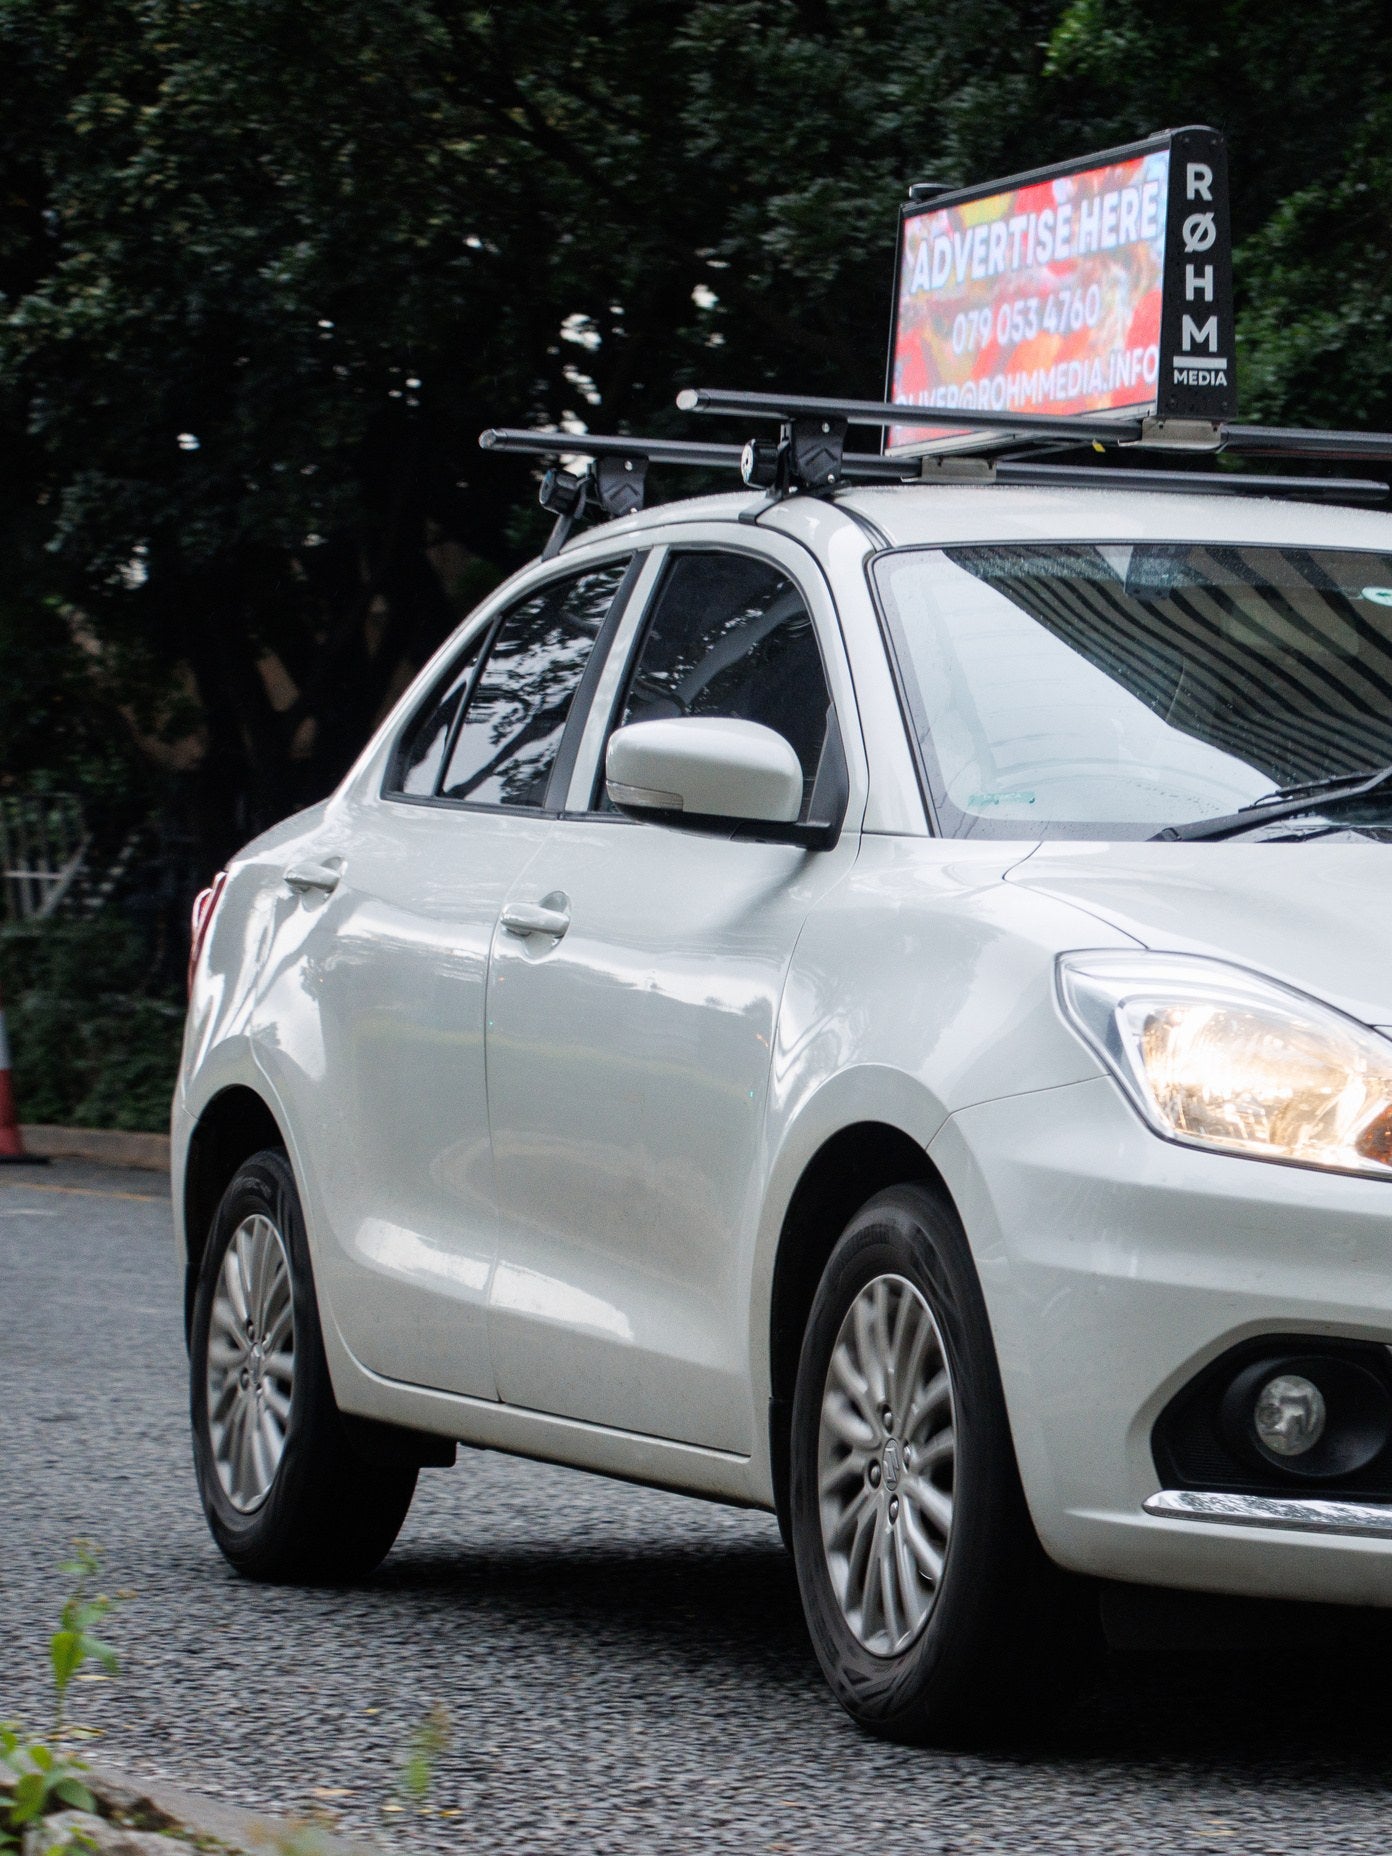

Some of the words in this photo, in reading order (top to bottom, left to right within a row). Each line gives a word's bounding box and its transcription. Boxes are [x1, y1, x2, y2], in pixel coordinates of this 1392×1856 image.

[910, 203, 1073, 294] ADVERTISE
[1077, 181, 1160, 254] HERE
[952, 307, 992, 356] 079
[996, 297, 1039, 346] 053
[1042, 283, 1101, 334] 4760
[895, 344, 1159, 413] ER@ROHMMEDIA.INFO
[1172, 369, 1227, 387] MEDIA
